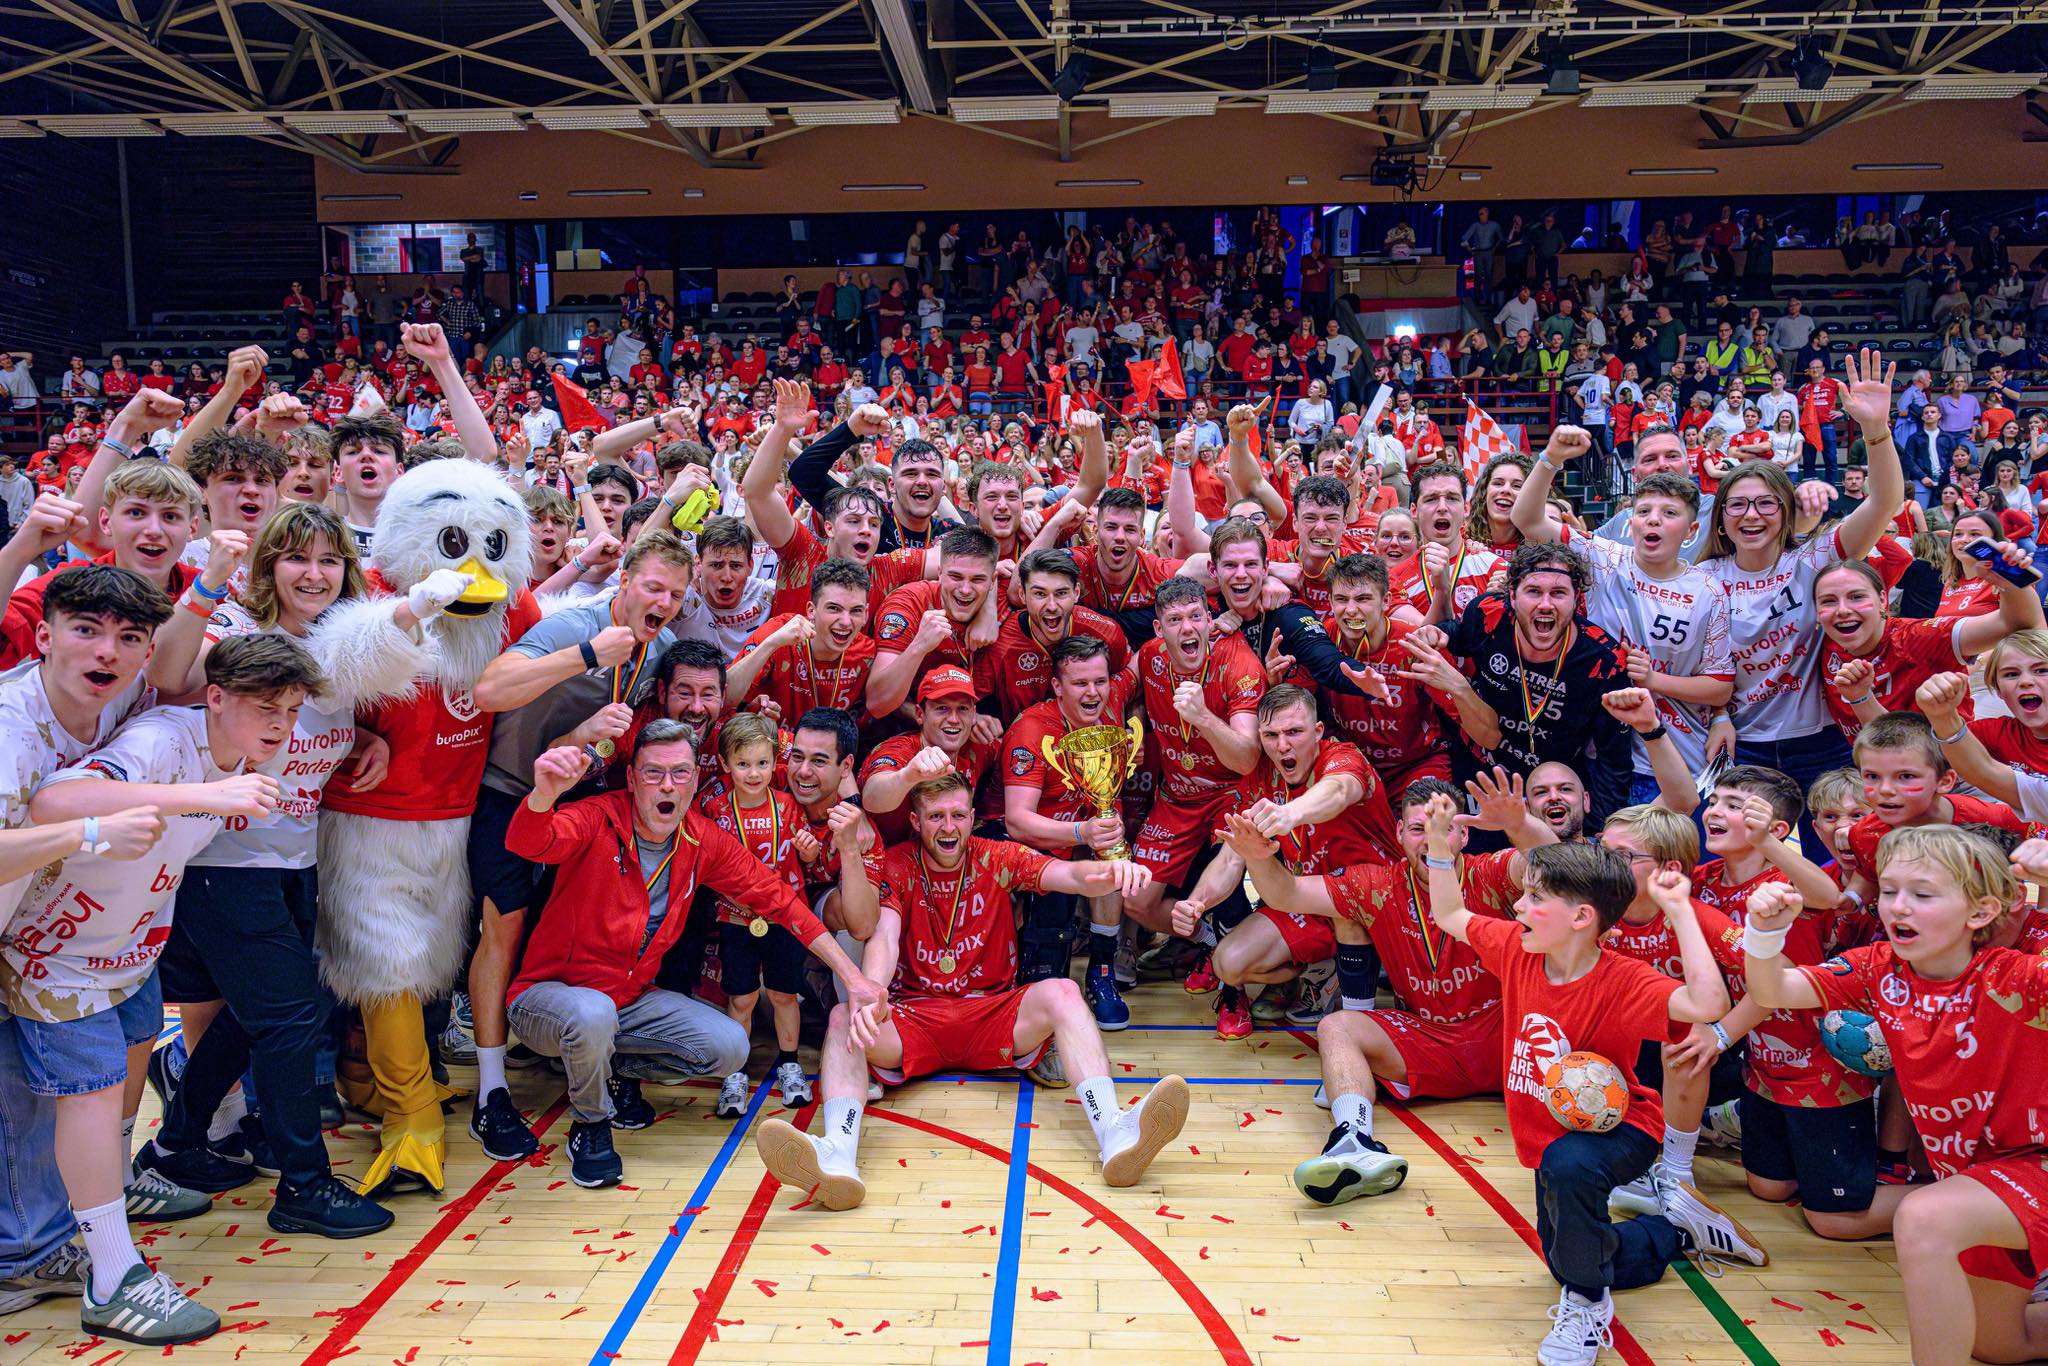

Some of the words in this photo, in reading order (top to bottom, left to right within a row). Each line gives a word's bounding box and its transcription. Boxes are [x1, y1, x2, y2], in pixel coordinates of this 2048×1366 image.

[328, 395, 343, 409] 22
[1958, 596, 1972, 610] 8
[1650, 613, 1691, 646] 55
[1016, 677, 1038, 687] CRAFT
[1510, 666, 1567, 694] ALTREA
[837, 689, 850, 711] 5
[287, 727, 354, 755] buropix
[436, 729, 480, 746] buropix
[757, 840, 791, 864] 24
[1513, 1038, 1533, 1060] WE
[1955, 1016, 1979, 1060] 5
[1509, 1058, 1535, 1079] ARE
[1085, 1090, 1099, 1111] CRAFT
[1991, 1169, 2032, 1202] CRAFT
